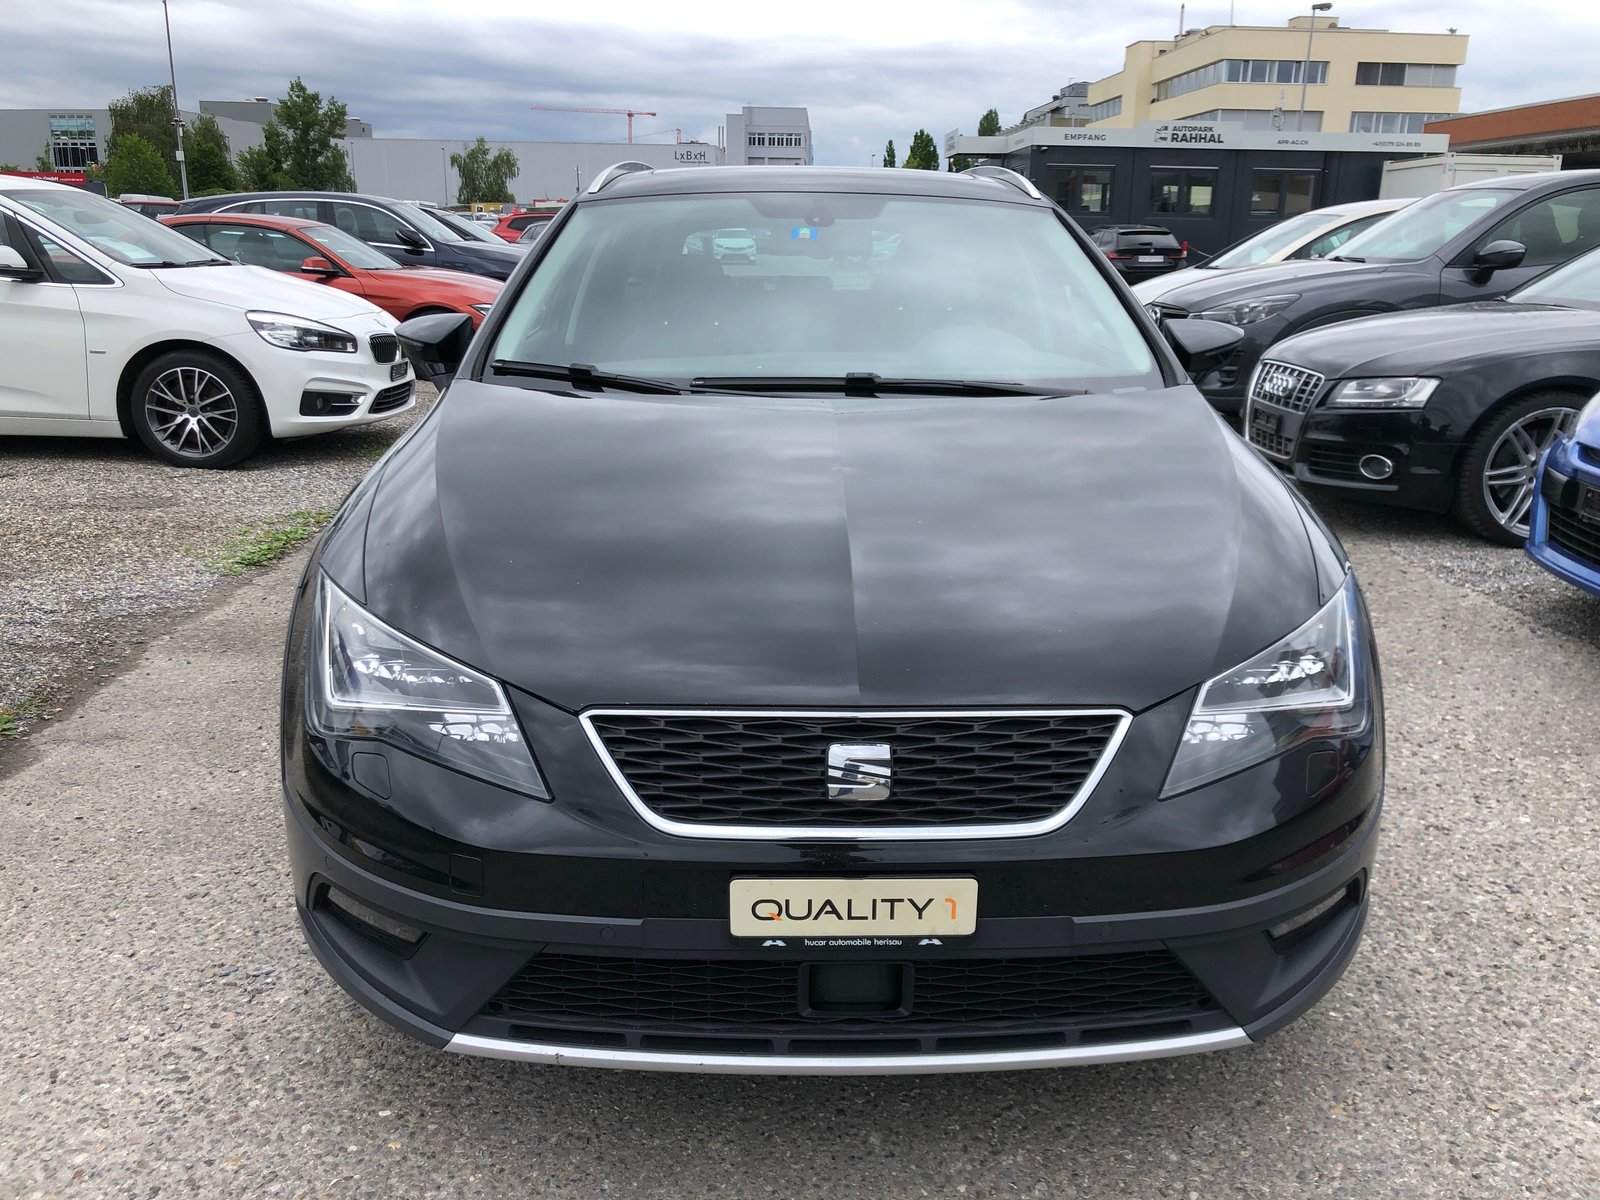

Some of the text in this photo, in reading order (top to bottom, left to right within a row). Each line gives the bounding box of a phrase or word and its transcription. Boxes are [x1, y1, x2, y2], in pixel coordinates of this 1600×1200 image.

[1172, 125, 1214, 133] AUTOPARK
[1064, 133, 1107, 142] EMPFANG
[1171, 133, 1224, 144] RAHHAL
[751, 897, 957, 921] QUALITY 1
[804, 938, 903, 947] hucar automobile herisau
